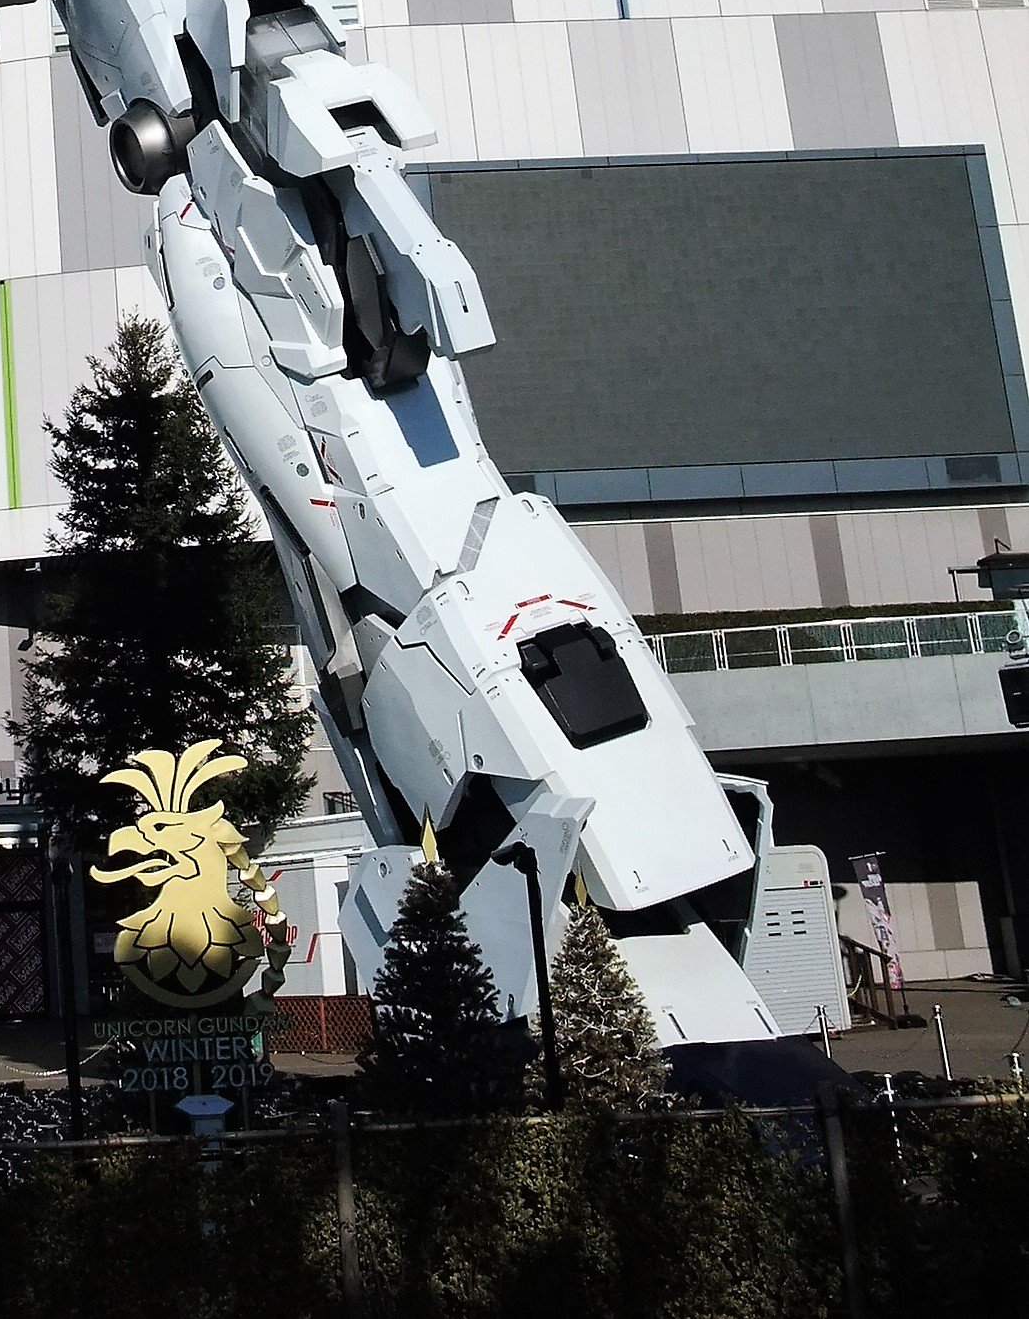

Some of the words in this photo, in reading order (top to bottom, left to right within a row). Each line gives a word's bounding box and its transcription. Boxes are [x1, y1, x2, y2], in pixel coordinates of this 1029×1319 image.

[93, 1019, 192, 1038] UNICORN
[197, 1015, 293, 1034] GUNDAM
[142, 1036, 250, 1063] WINTER
[123, 1066, 189, 1093] 2018
[211, 1062, 276, 1090] 2019
